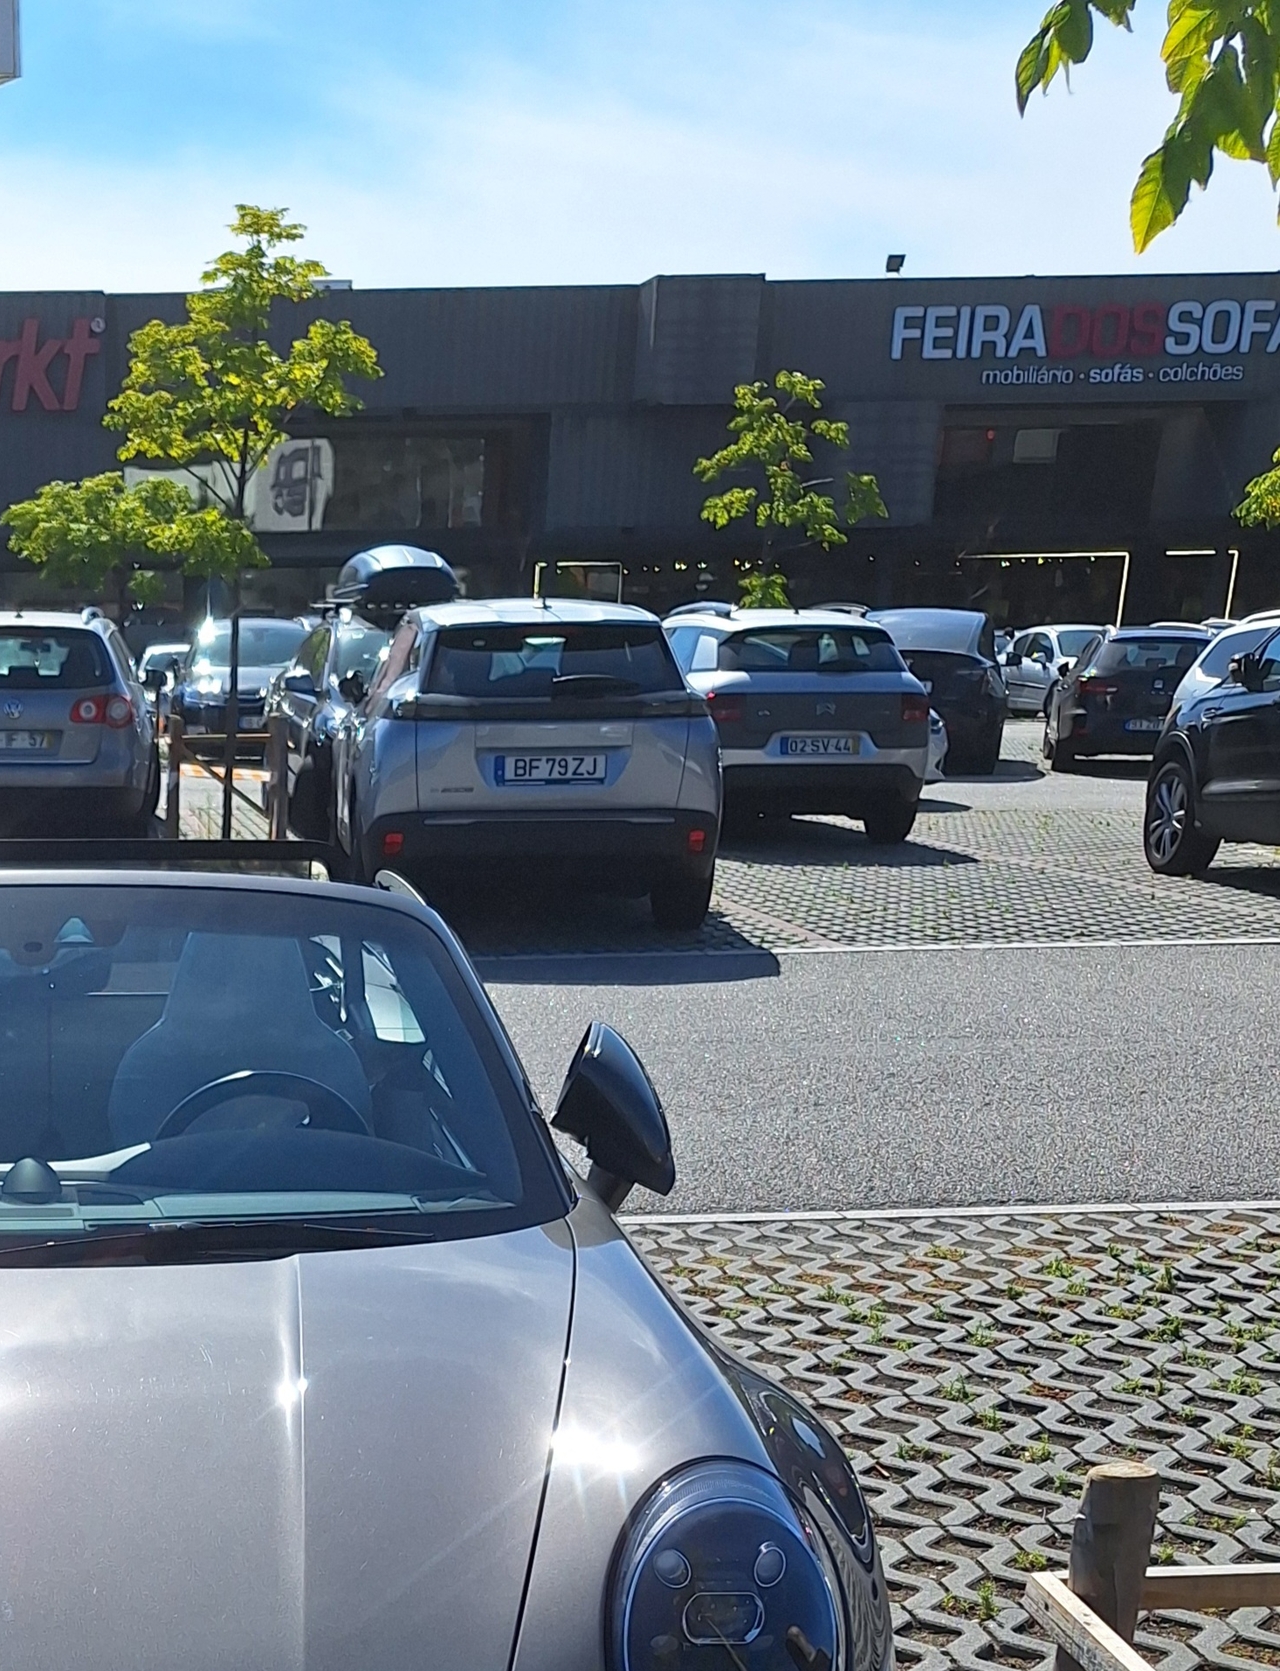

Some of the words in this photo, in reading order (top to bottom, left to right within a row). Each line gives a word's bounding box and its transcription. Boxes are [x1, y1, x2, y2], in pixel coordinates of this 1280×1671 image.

[982, 366, 1073, 384] mobiliário
[1089, 363, 1144, 383] sofás
[1159, 362, 1244, 382] colchões
